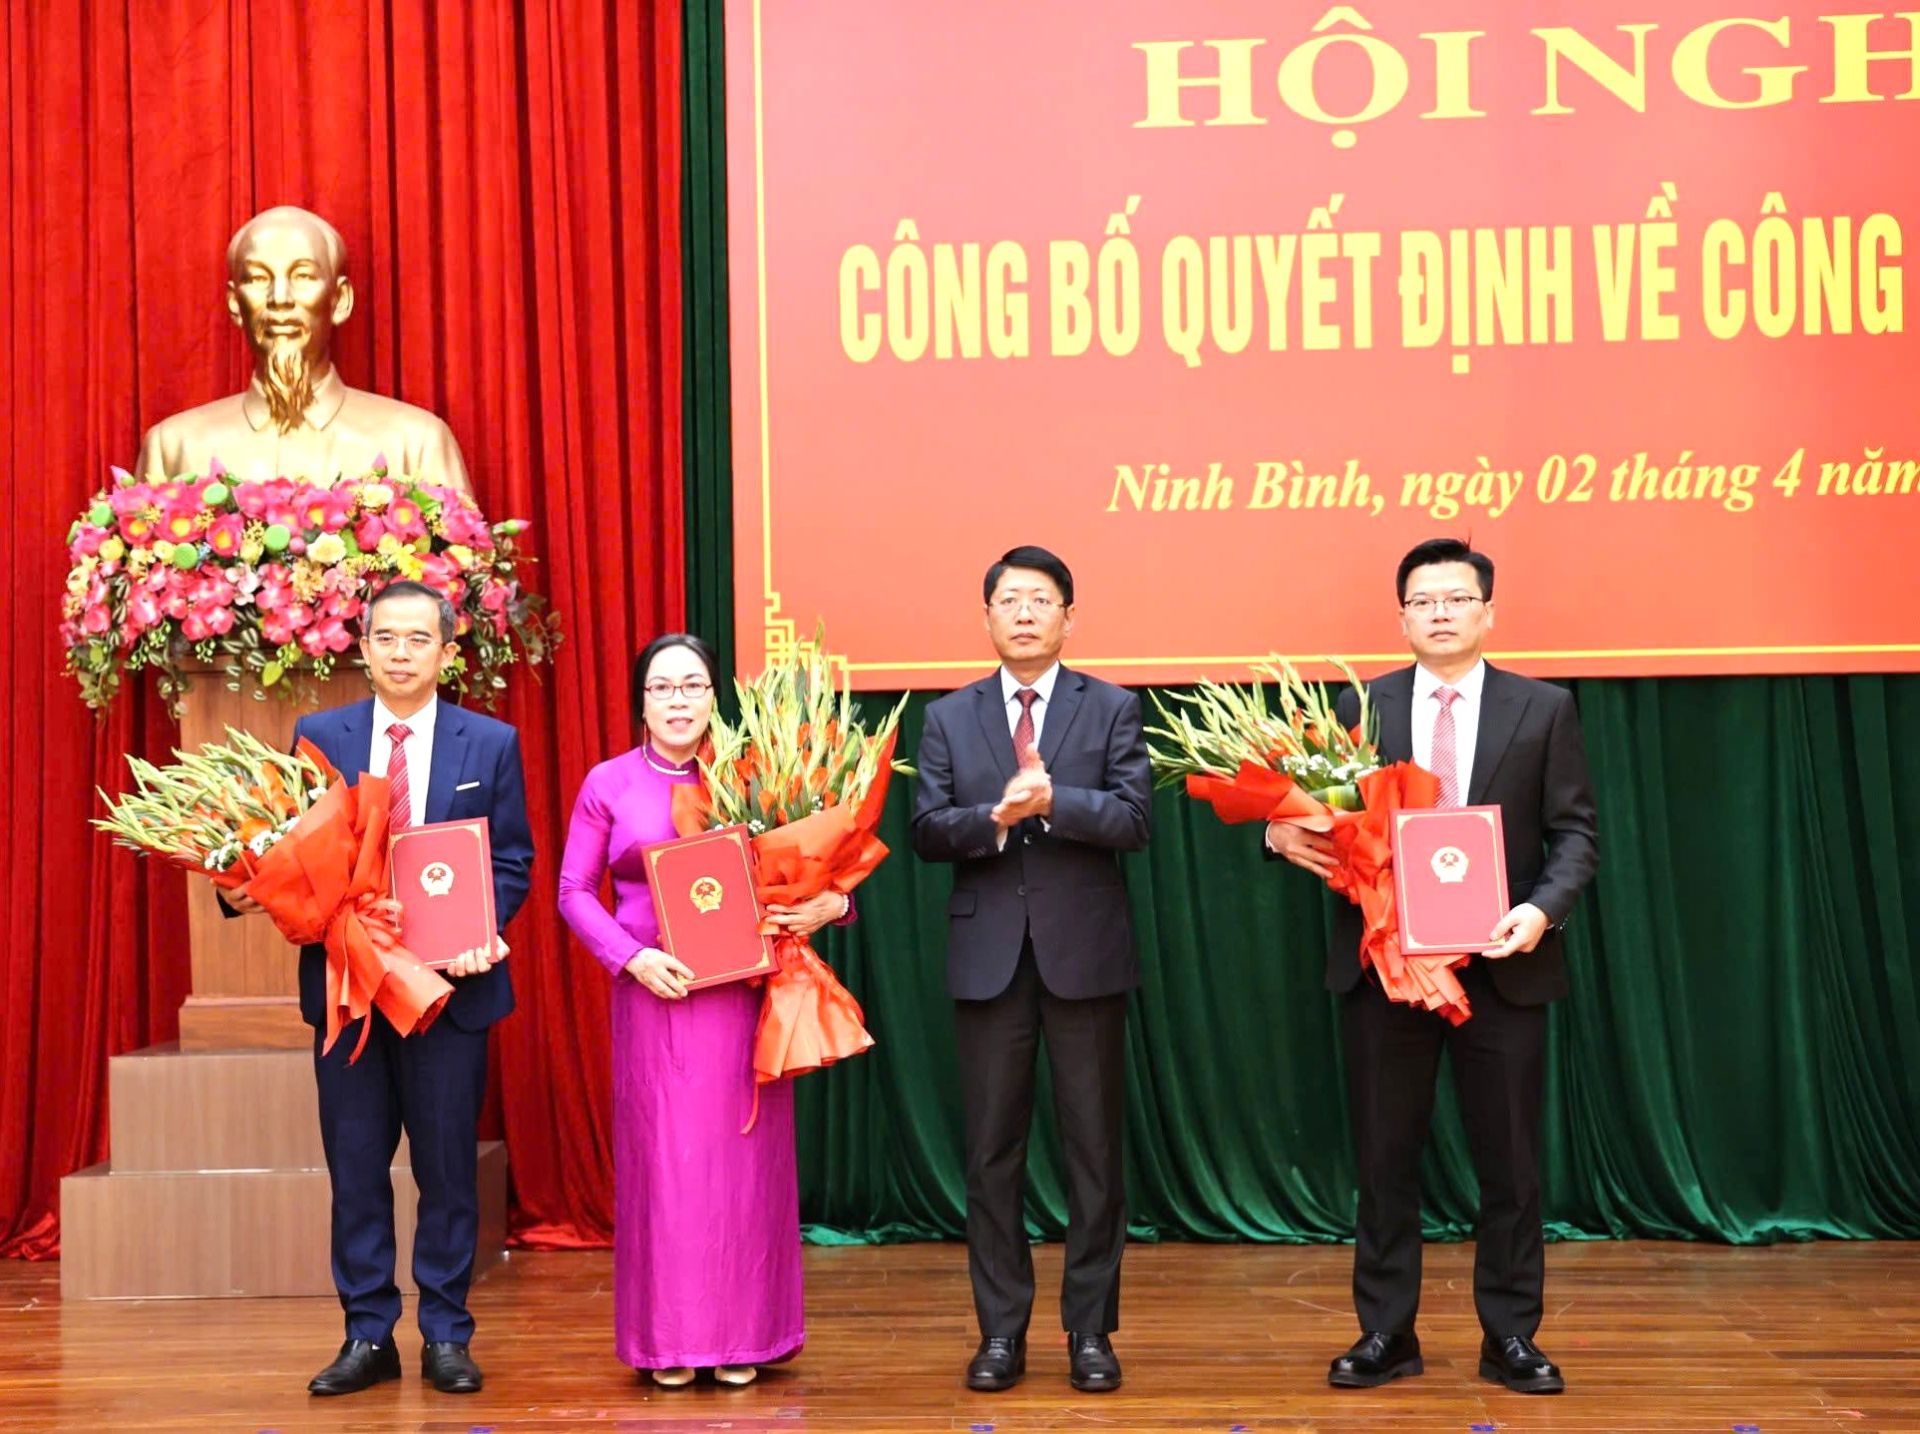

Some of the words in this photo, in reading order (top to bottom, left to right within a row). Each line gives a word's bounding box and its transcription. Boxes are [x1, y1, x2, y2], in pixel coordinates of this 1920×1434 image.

[1130, 5, 1488, 149] HỘI
[1530, 11, 1920, 116] NGH
[838, 217, 1030, 364] CÔNG
[1048, 194, 1142, 357] BỐ
[1161, 192, 1382, 369] QUYẾT
[1397, 225, 1574, 375] ĐỊNH
[1592, 181, 1680, 342] VỀ
[1701, 191, 1903, 340] CÔNG
[1105, 462, 1234, 513] Ninh
[1246, 459, 1385, 517] Bình,
[1399, 455, 1524, 520] ngày
[1536, 453, 1597, 504] 02
[1609, 450, 1761, 512] tháng
[1772, 448, 1805, 497] 4
[1816, 446, 1920, 496] năm
